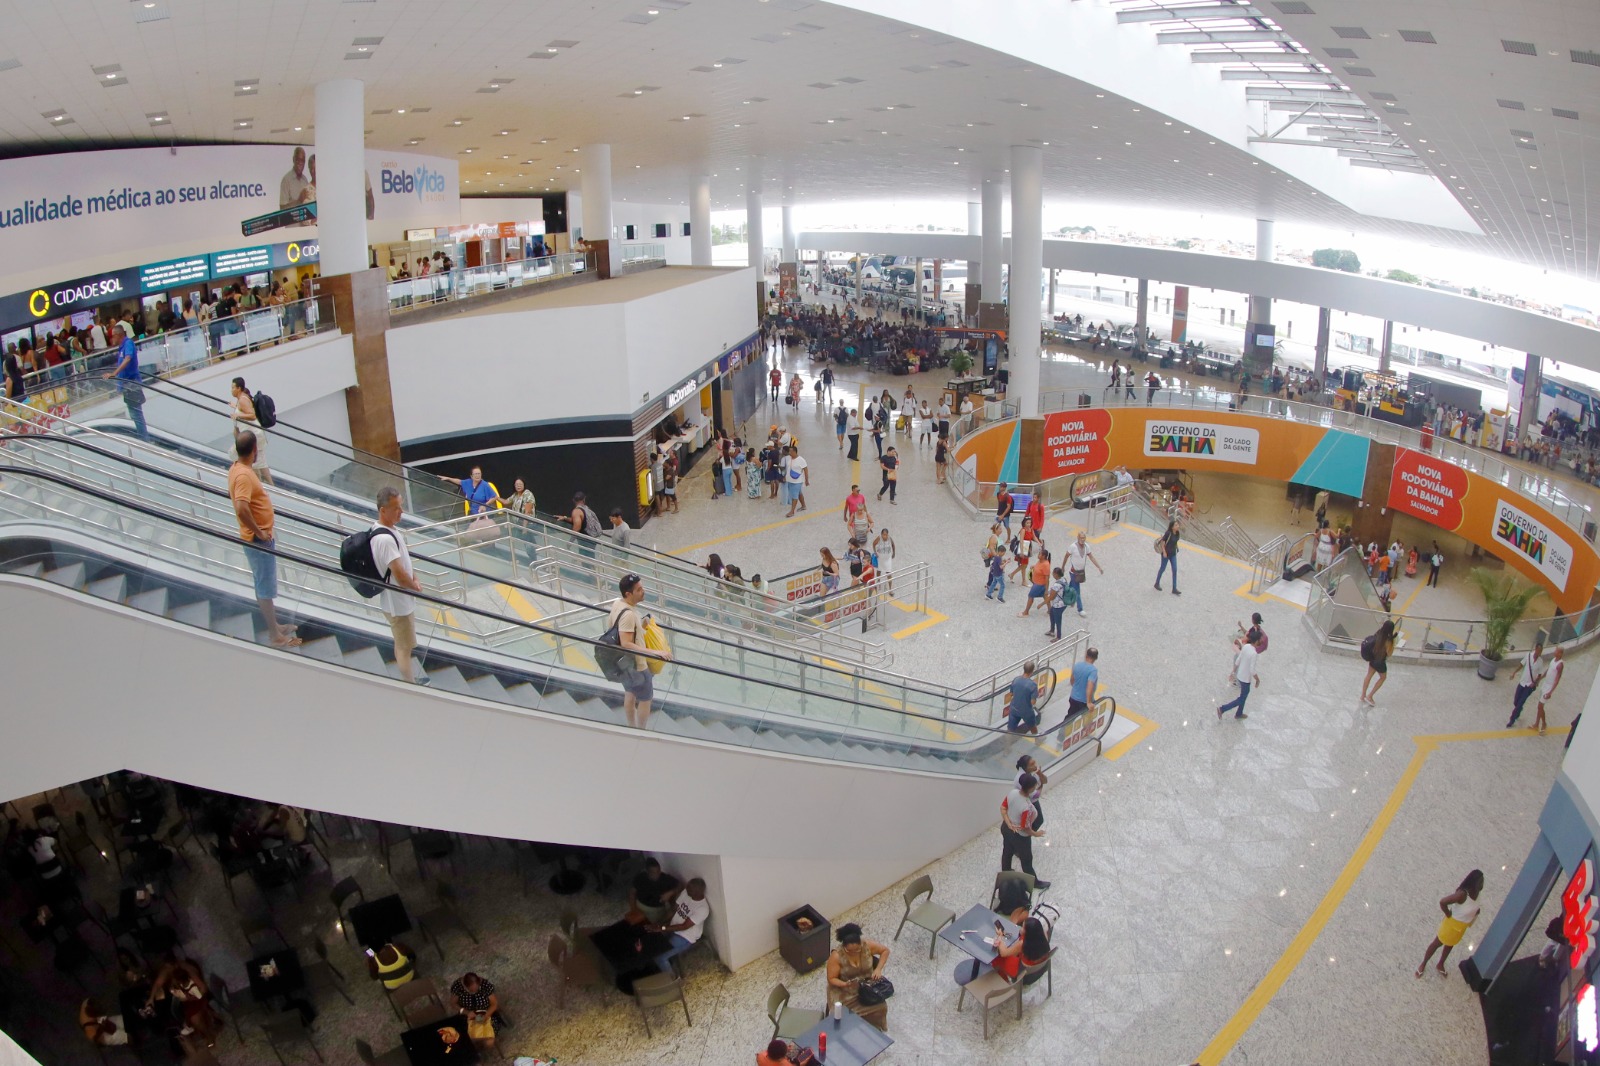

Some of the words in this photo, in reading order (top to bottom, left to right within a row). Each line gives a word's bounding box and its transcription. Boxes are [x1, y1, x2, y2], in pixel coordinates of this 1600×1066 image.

[87, 187, 152, 214] médica
[155, 188, 176, 205] ao
[179, 186, 206, 203] seu
[210, 180, 267, 200] alcance.
[54, 283, 99, 306] CIDADE
[100, 278, 123, 295] SOL
[1061, 421, 1085, 433] NOVA
[1151, 425, 1200, 436] GOVERNO
[1202, 428, 1216, 438] DA
[1047, 430, 1098, 447] RODOVIÁRIA
[1150, 434, 1216, 455] BAHIA
[1053, 447, 1064, 458] DA
[1065, 444, 1090, 456] BAHIA
[1057, 457, 1086, 468] SALVADOR
[1417, 464, 1442, 481] NOVA
[1401, 471, 1454, 499] RODOVIÁRIA
[1406, 485, 1419, 498] DA
[1419, 489, 1445, 508] BAHIA
[1410, 499, 1439, 517] SALVADOR
[1501, 507, 1538, 536] GOVERNO
[1538, 529, 1548, 544] DA
[1496, 517, 1544, 565] BAHIA
[1550, 548, 1557, 558] DO
